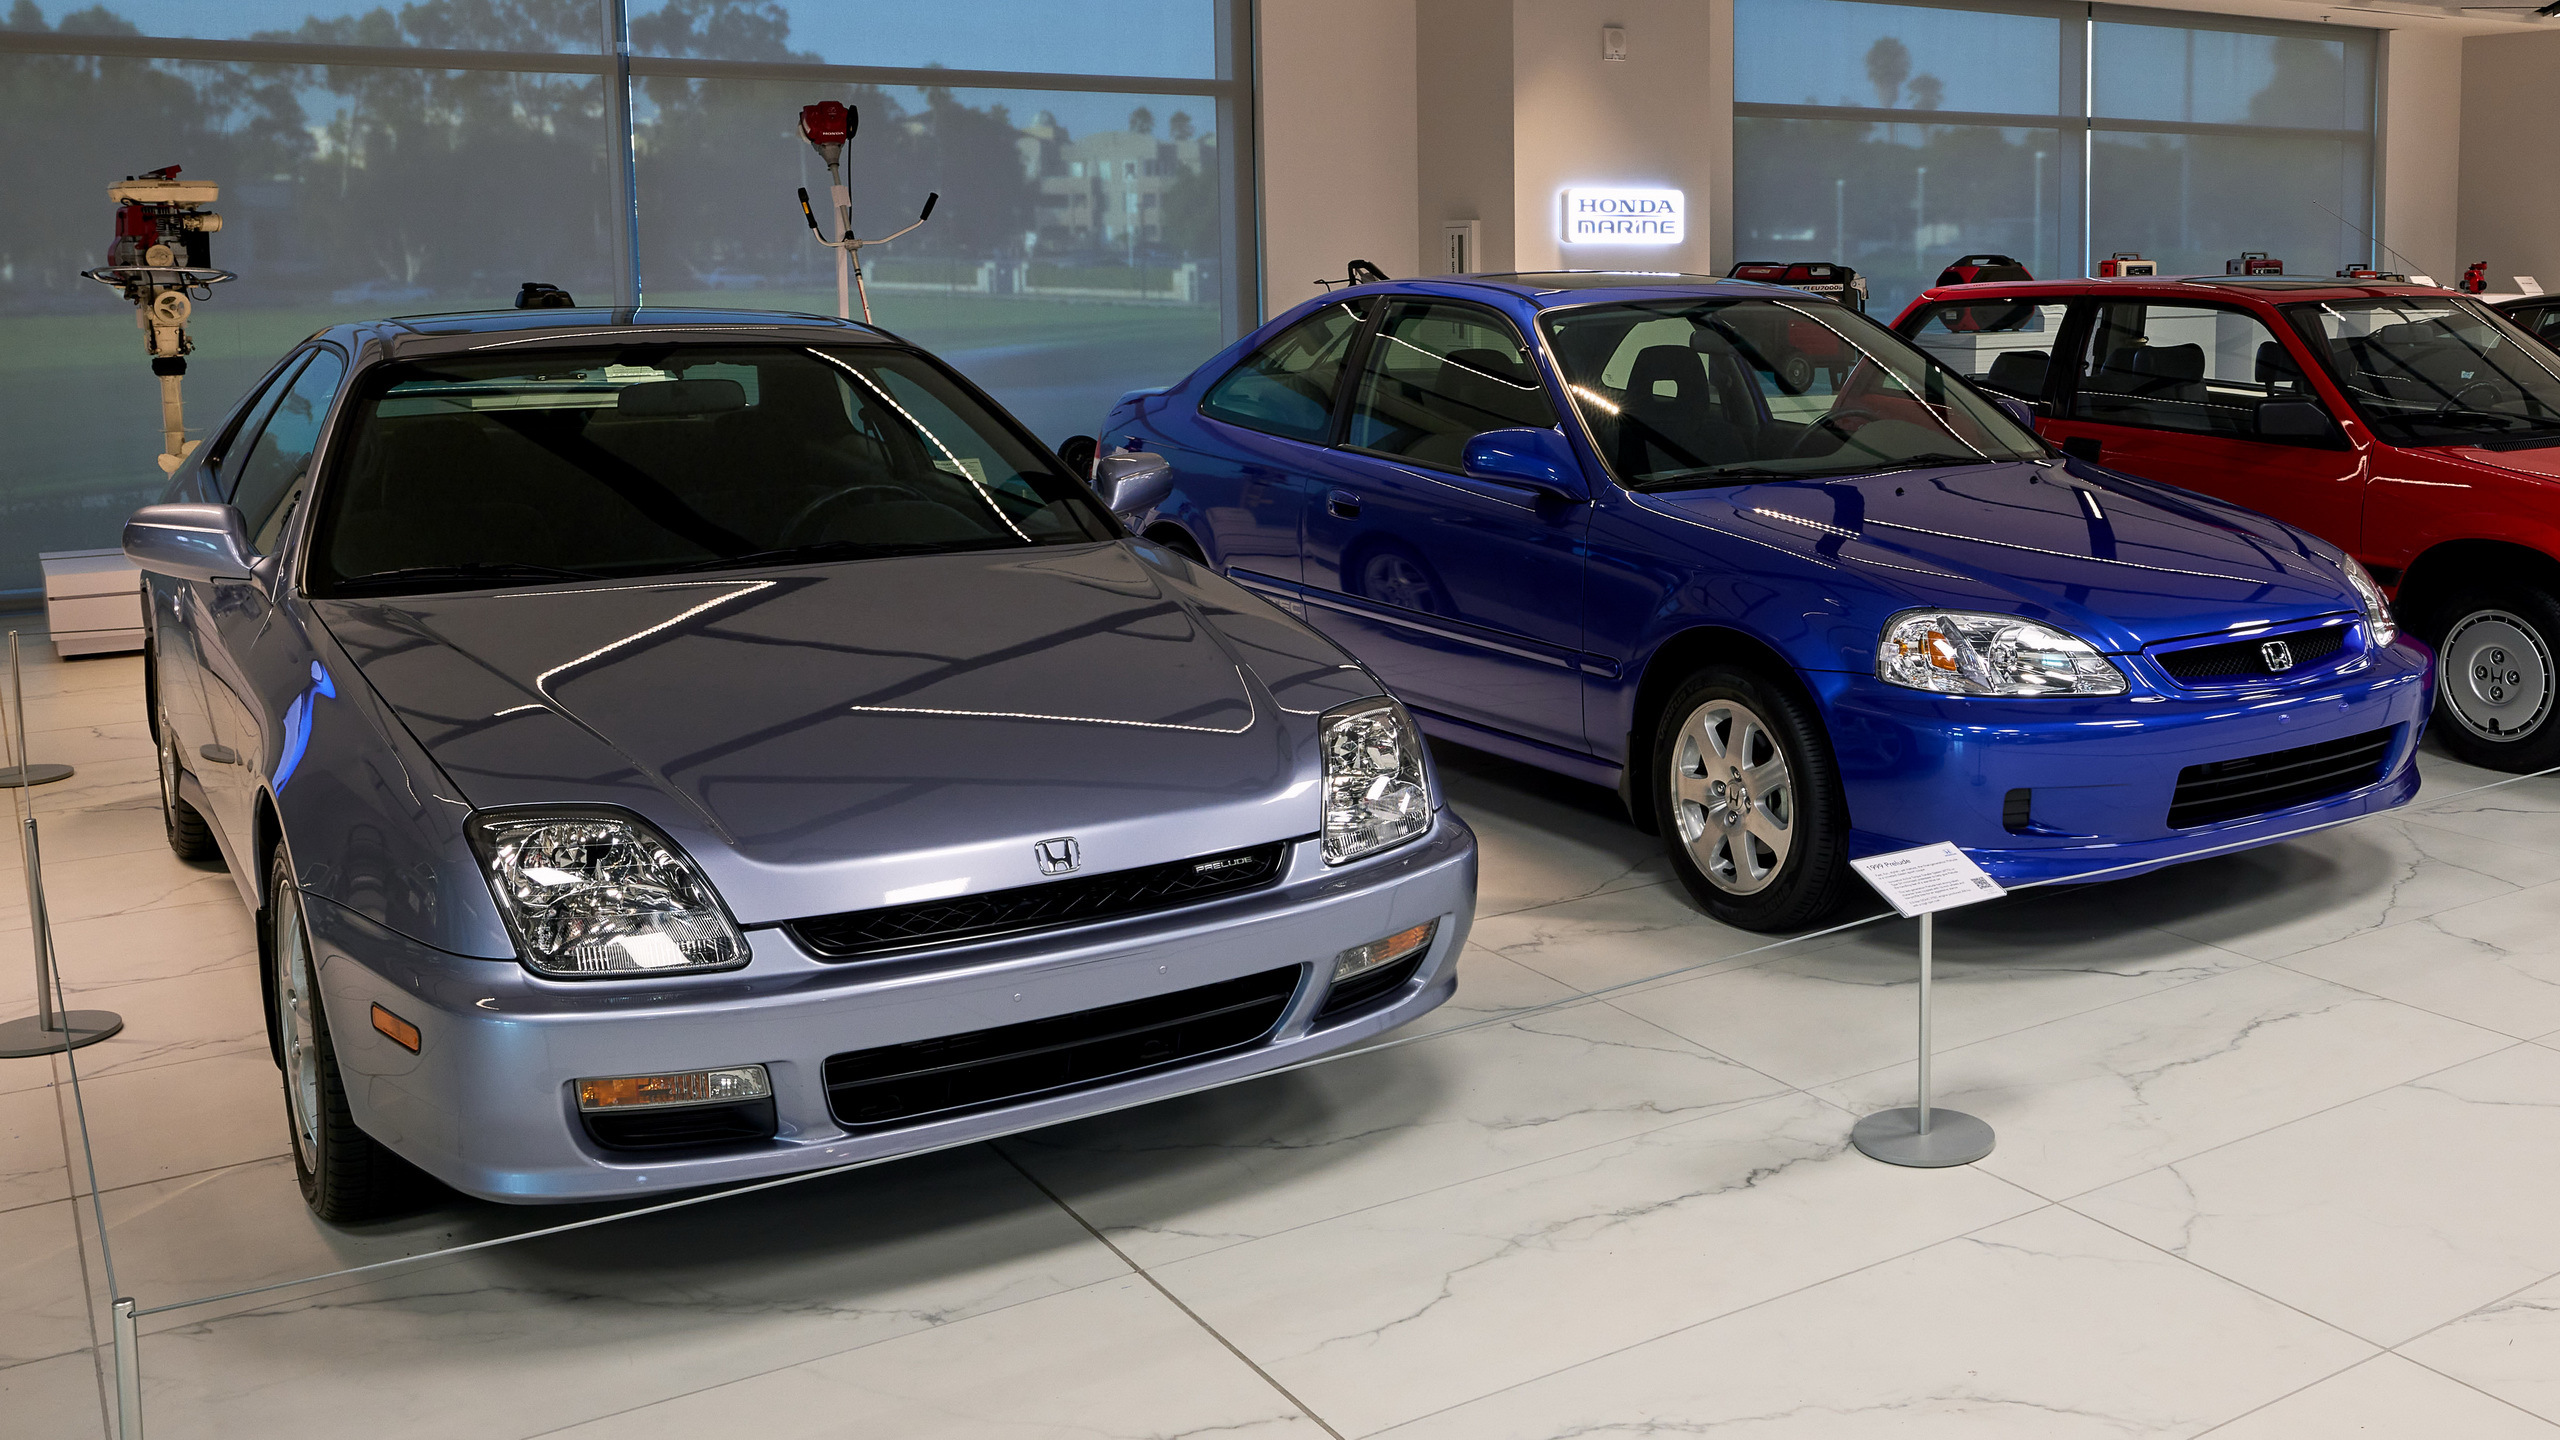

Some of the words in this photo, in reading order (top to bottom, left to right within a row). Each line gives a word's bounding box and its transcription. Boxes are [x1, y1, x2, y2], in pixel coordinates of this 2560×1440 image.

[1578, 198, 1676, 213] HONDA
[1195, 856, 1253, 874] PRELUDE
[1866, 862, 1884, 871] 1999
[1884, 858, 1912, 868] Prelude
